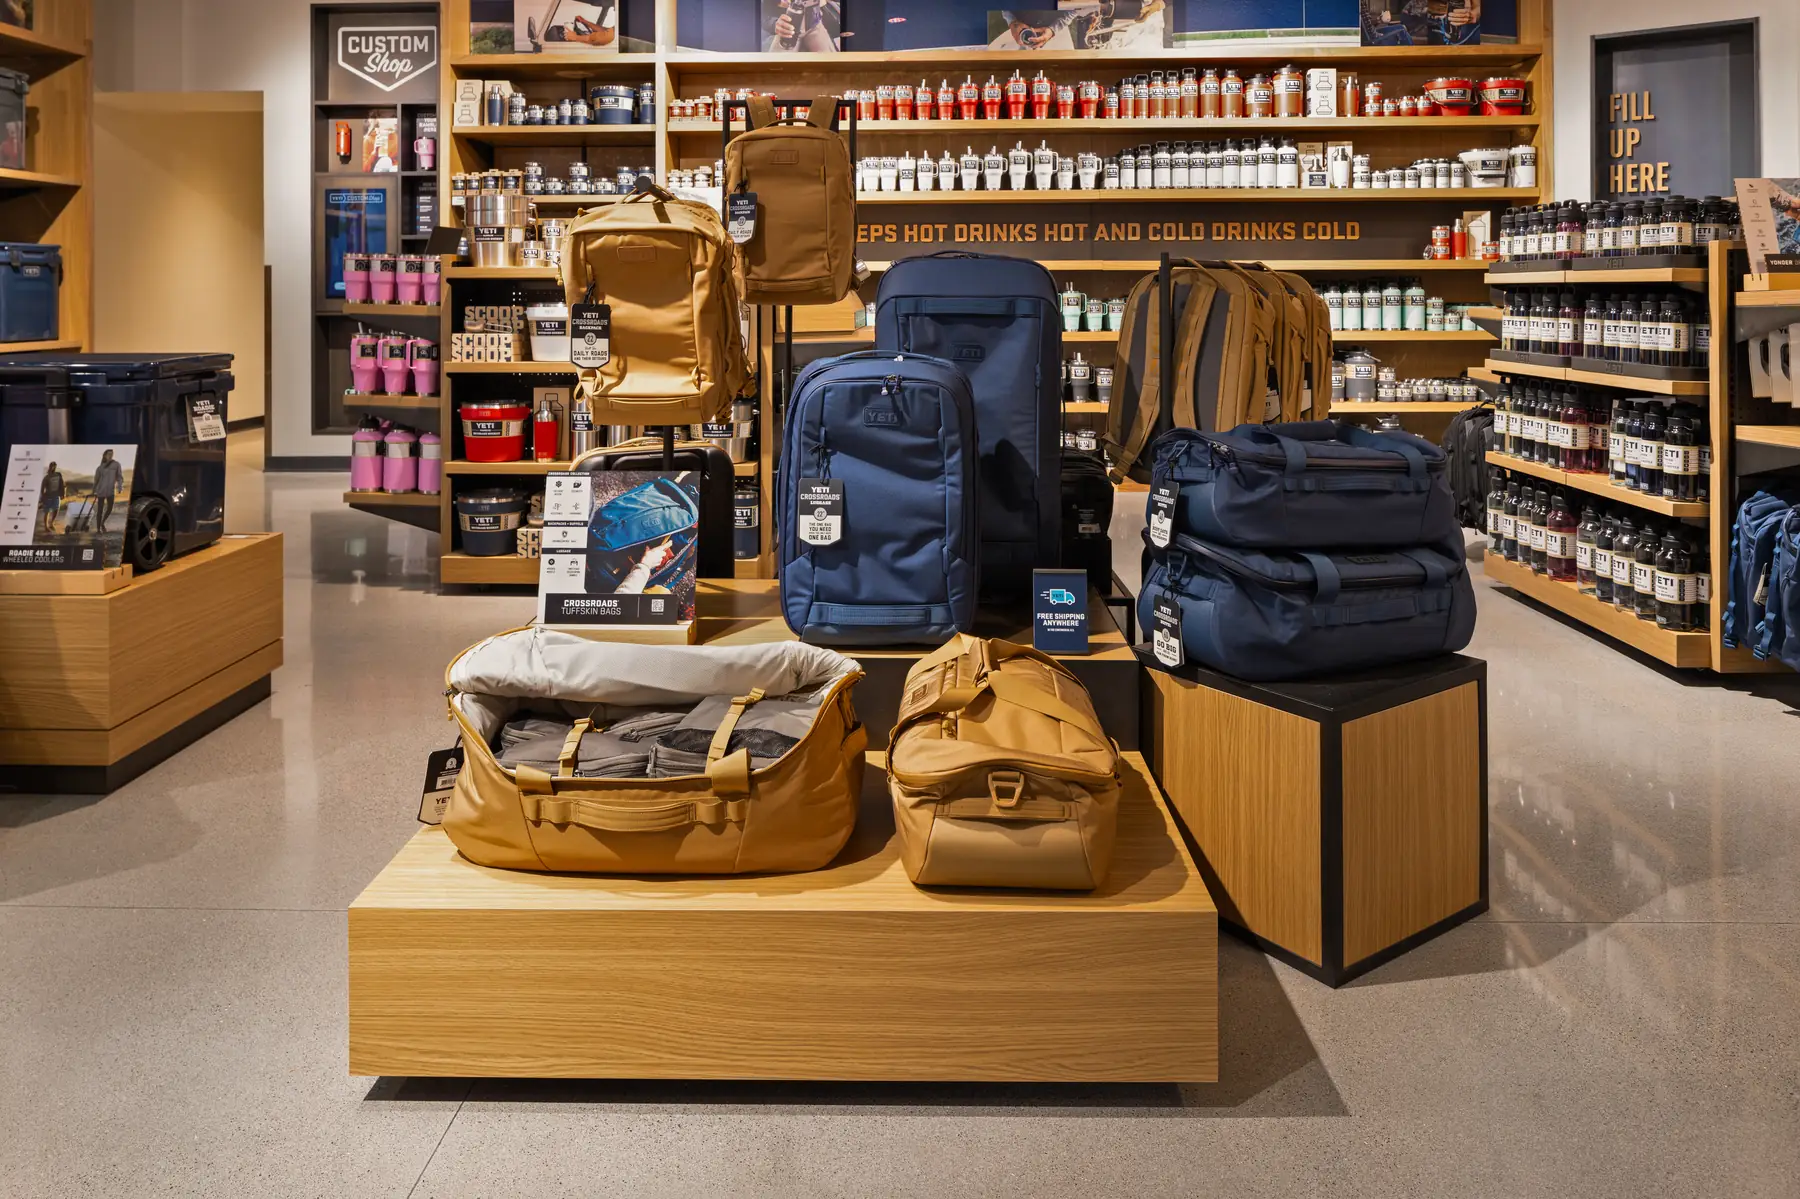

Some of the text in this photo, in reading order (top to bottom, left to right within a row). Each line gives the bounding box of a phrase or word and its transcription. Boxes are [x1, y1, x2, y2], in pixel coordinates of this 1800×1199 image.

[348, 36, 428, 54] CUSTOM
[364, 51, 414, 79] Shop
[1610, 90, 1655, 122] FILL
[1610, 128, 1641, 158] UP
[1610, 162, 1670, 193] HERE
[856, 222, 1360, 242] EPS HOT DRINKS HOT AND COLD DRINKS COLD
[465, 306, 524, 320] SCOOP
[452, 334, 512, 348] SCOOP
[452, 348, 512, 362] SCOOP
[1159, 488, 1170, 496] YETI
[561, 607, 621, 616] TUFFSKIN BAGS
[1160, 605, 1172, 615] YETI
[1157, 640, 1164, 648] GO
